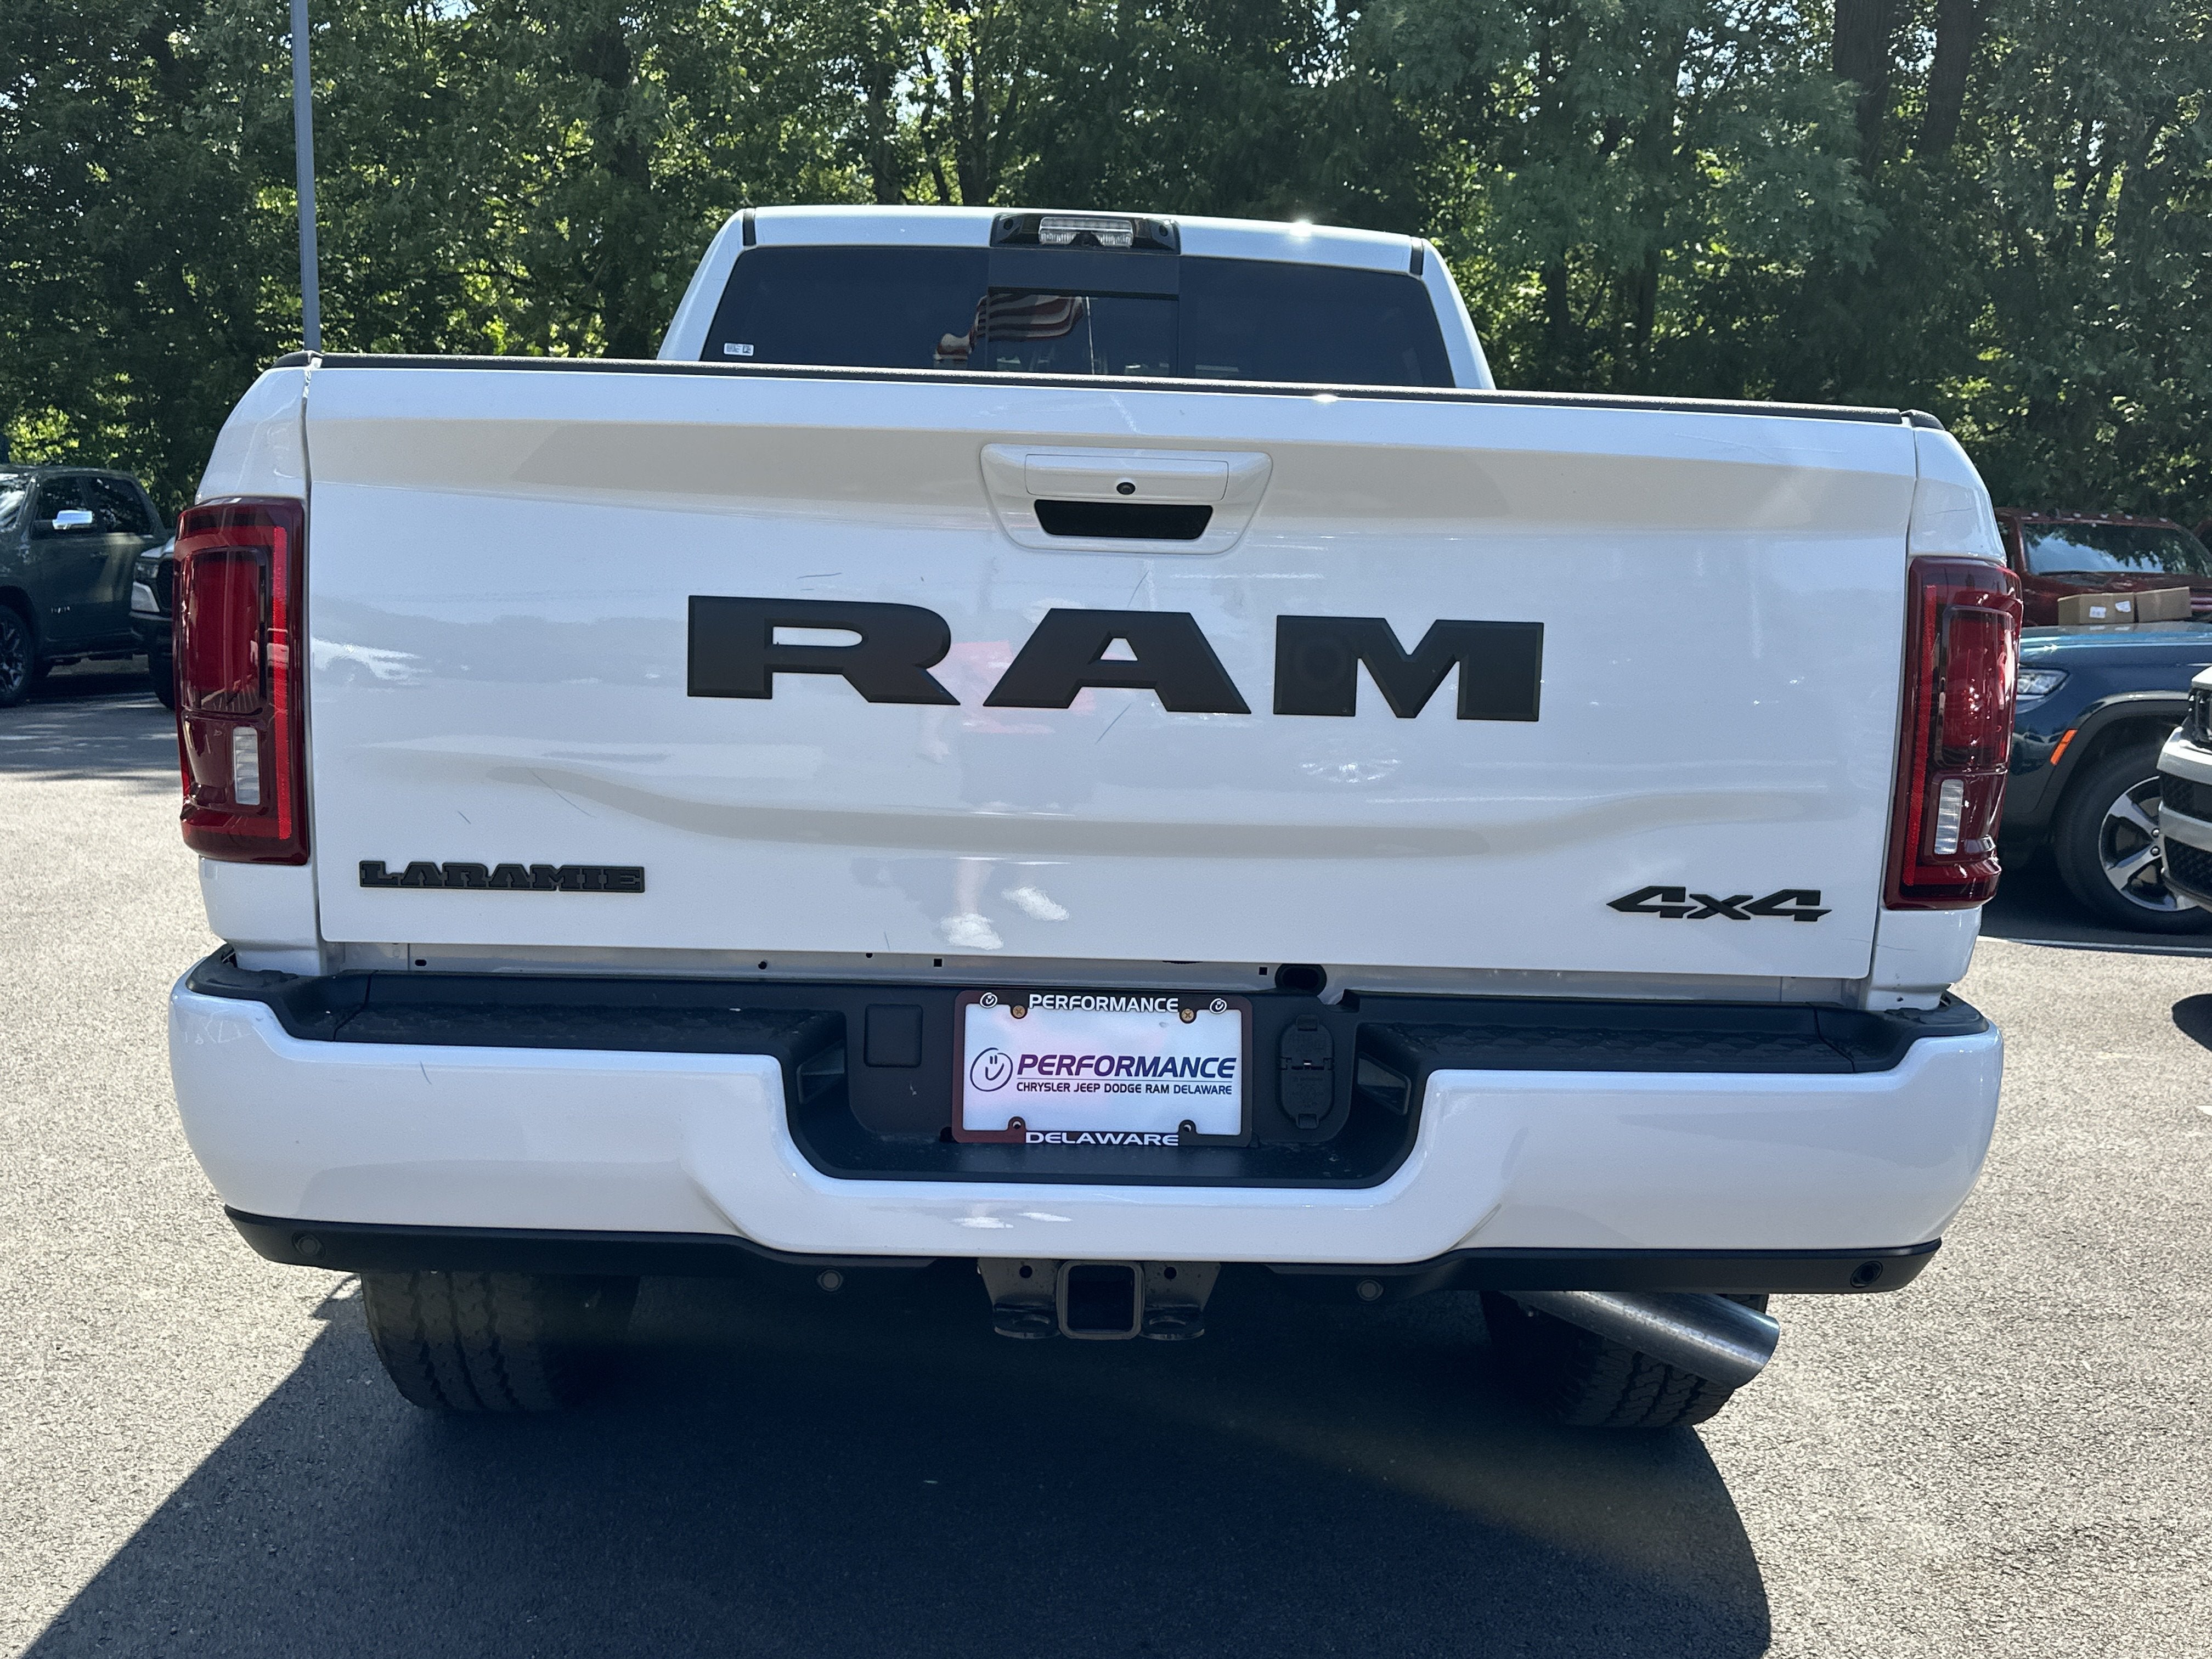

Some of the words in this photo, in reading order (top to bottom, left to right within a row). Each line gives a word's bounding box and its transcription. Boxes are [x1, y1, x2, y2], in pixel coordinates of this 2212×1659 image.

[687, 595, 1544, 721] RAM
[359, 860, 645, 893] LARAMIE
[1606, 885, 1832, 922] 4x4
[1029, 994, 1179, 1013] PERFORMANCE
[1017, 1053, 1237, 1079] PERFORMANCE
[1016, 1081, 1070, 1093] CHRYSLER
[1073, 1082, 1101, 1093] JEEP
[1104, 1083, 1142, 1094] DODGE
[1145, 1084, 1170, 1094] RAM
[1173, 1084, 1232, 1095] DELAWARE
[1025, 1131, 1179, 1146] DELAWARE
